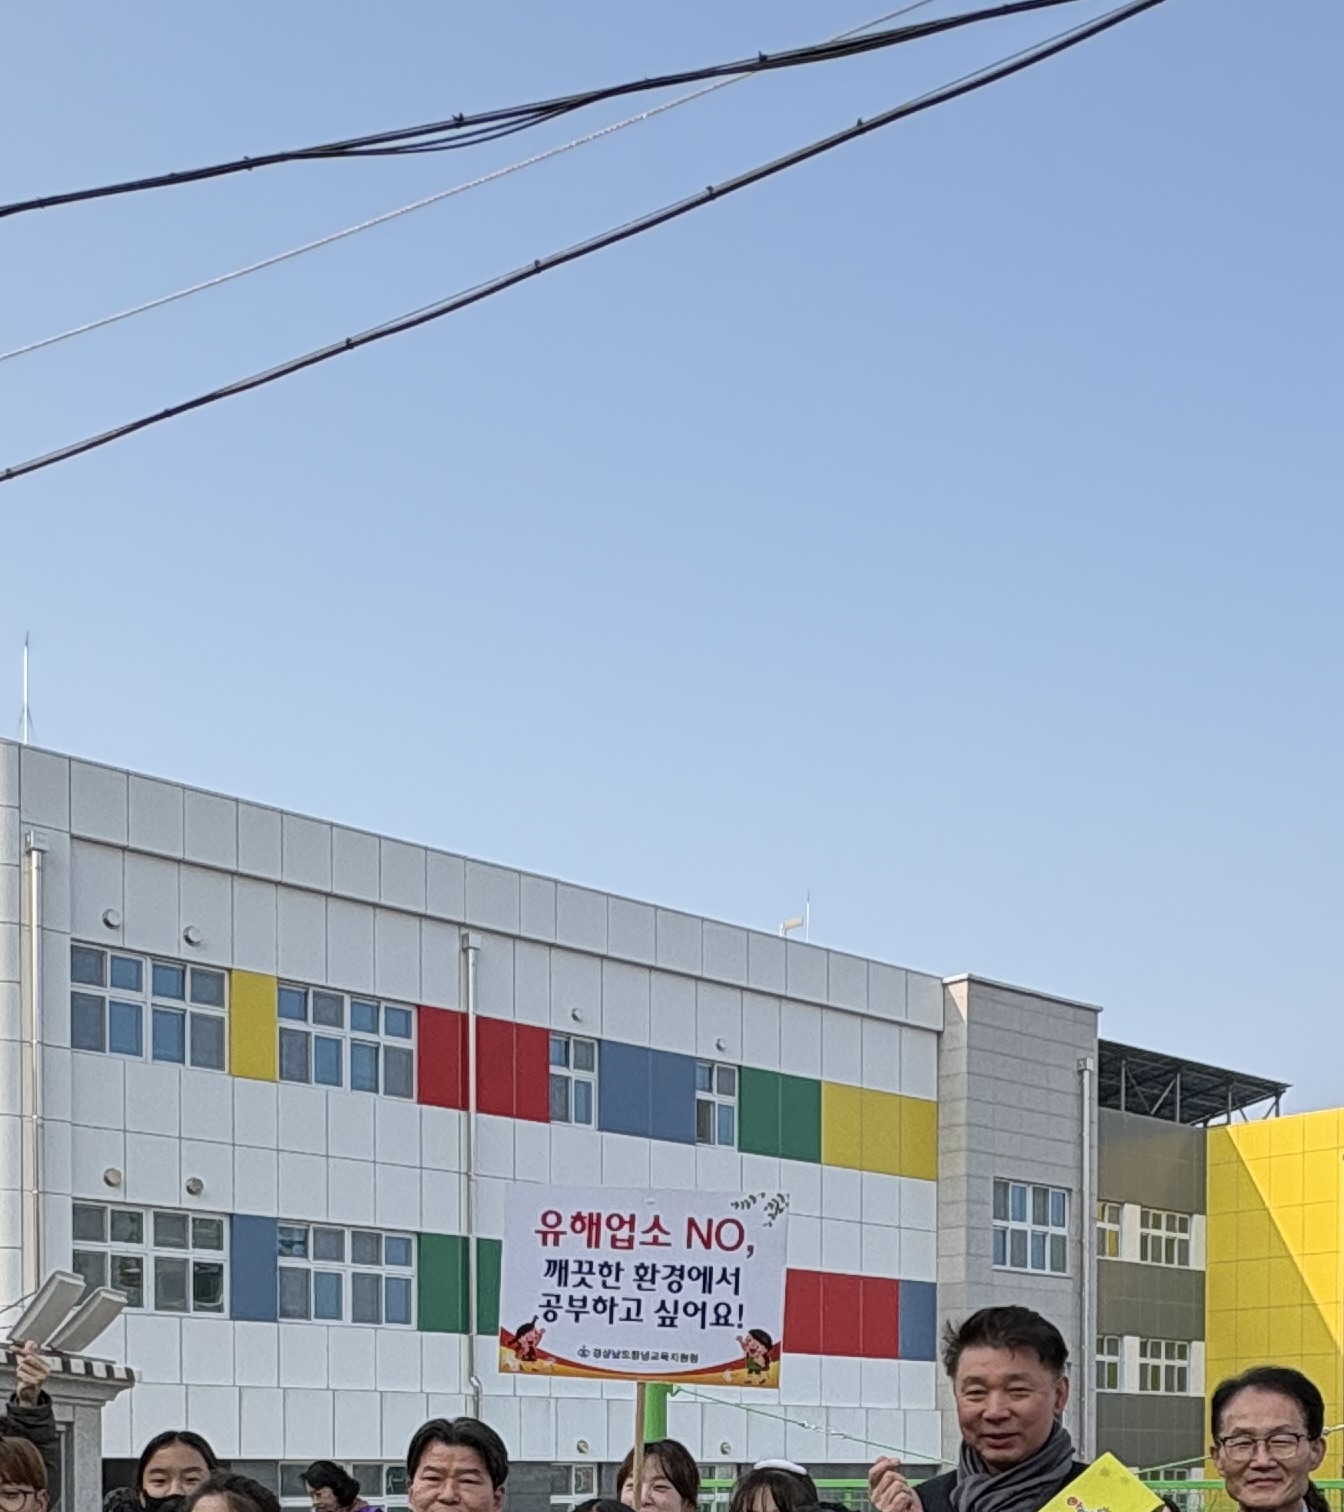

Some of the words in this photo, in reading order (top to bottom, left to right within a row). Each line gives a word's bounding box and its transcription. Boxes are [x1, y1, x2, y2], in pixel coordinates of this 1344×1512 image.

[534, 1209, 672, 1251] 유해업소
[685, 1216, 755, 1259] NO,
[543, 1258, 625, 1291] 깨끗한
[632, 1262, 741, 1297] 환경에서
[538, 1292, 644, 1325] 공부하고
[653, 1298, 745, 1330] 싶어요!
